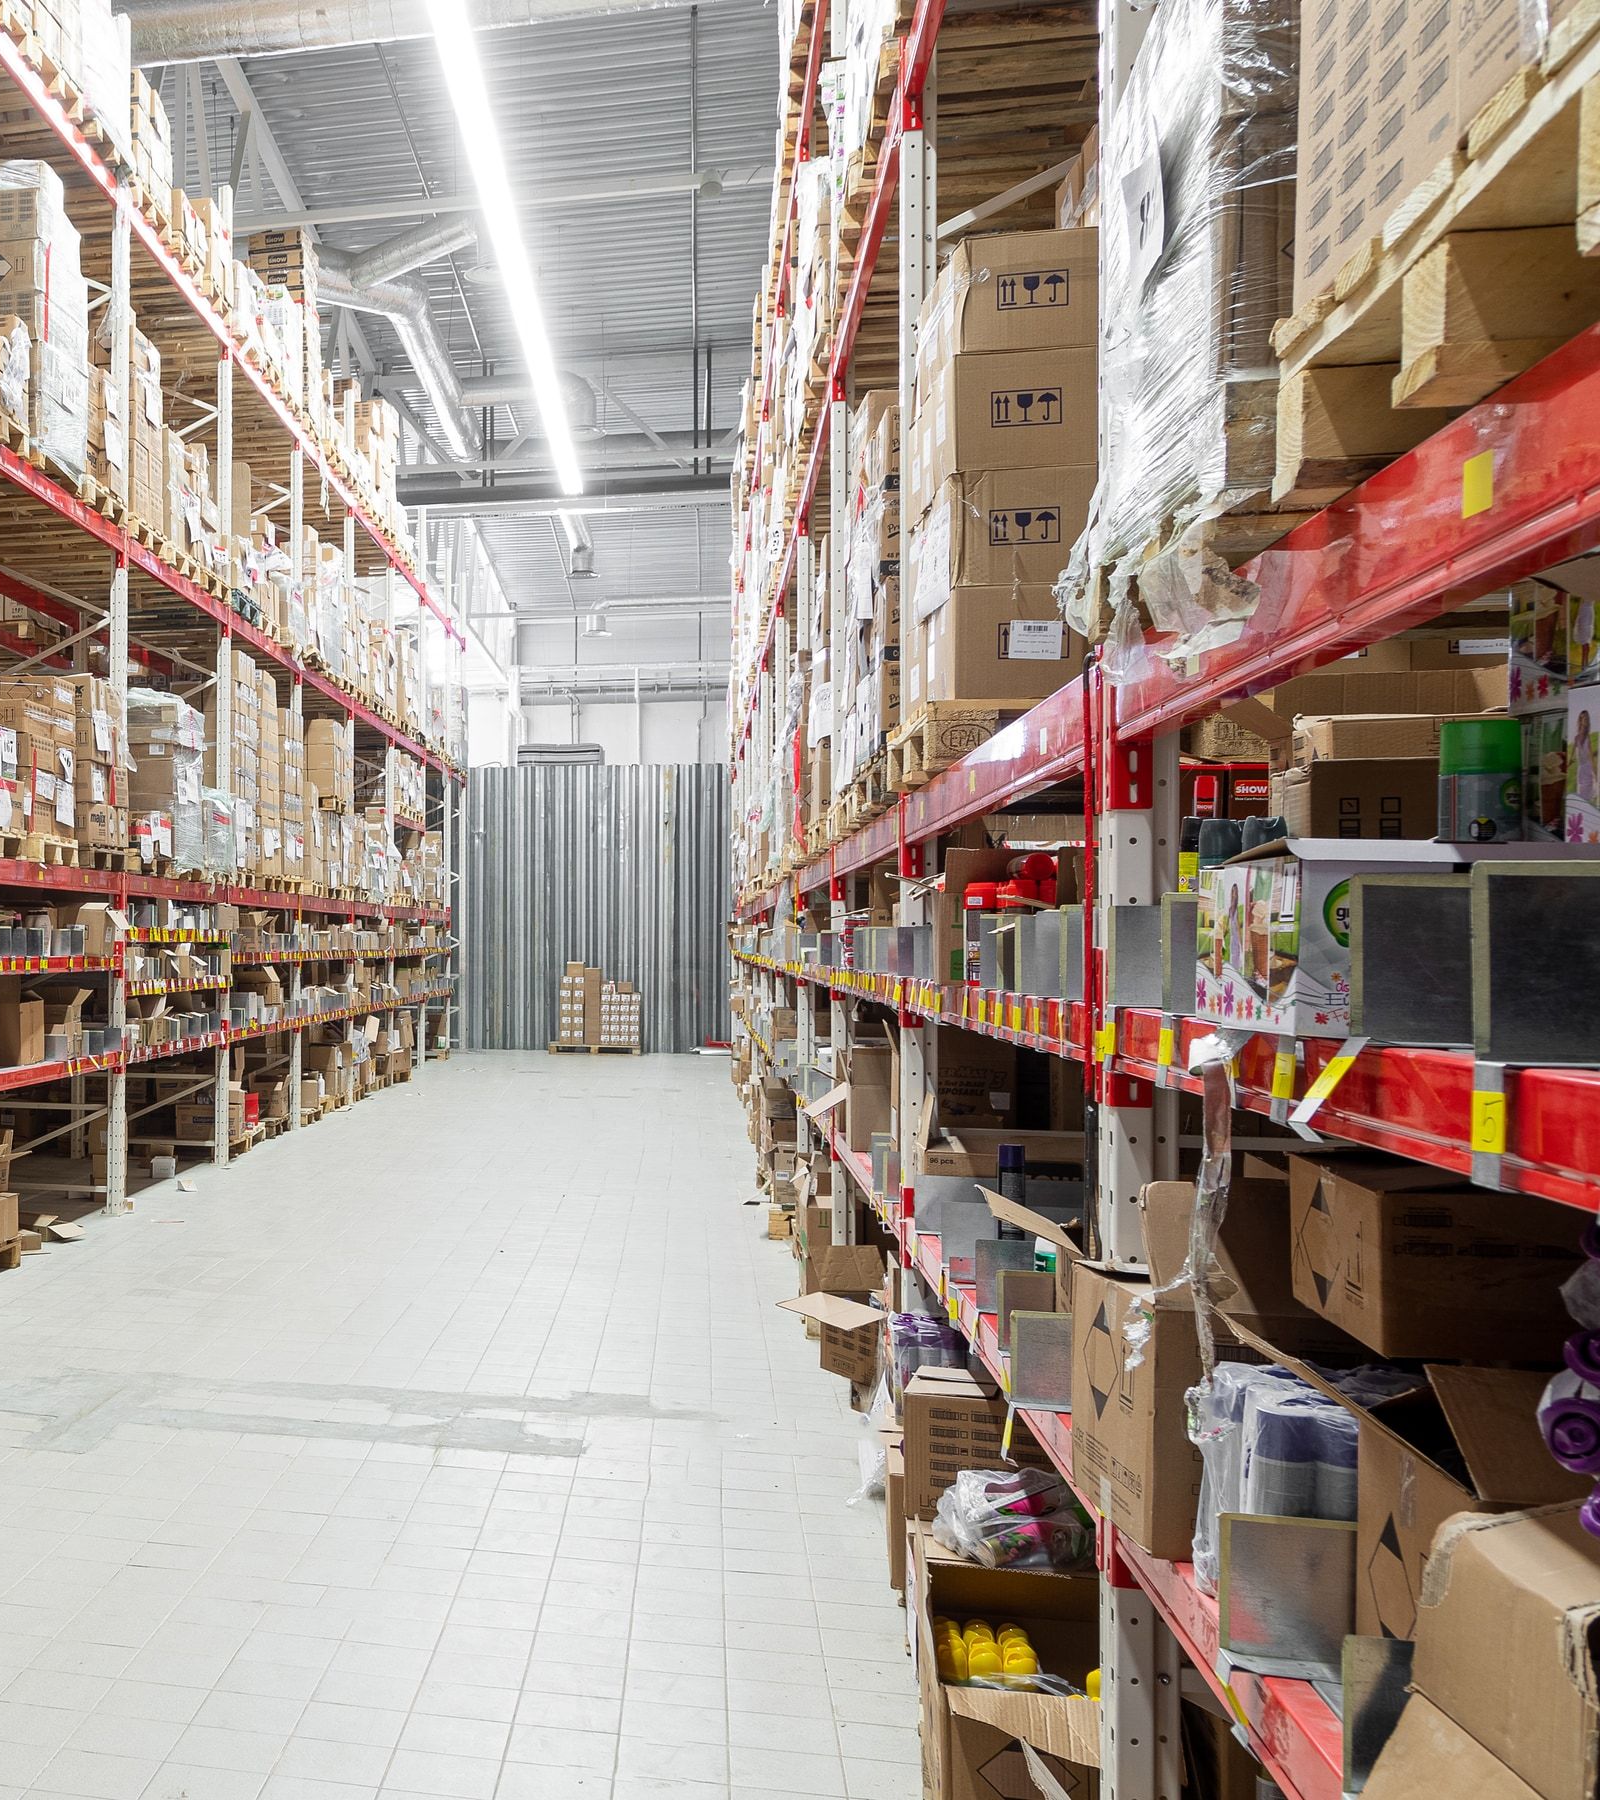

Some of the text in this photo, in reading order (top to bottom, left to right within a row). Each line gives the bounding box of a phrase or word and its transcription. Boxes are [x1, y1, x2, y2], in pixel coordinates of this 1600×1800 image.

[949, 724, 982, 746] EPAL
[1235, 784, 1268, 794] SHOW
[90, 812, 106, 825] majix
[929, 1157, 956, 1167] 96 pcs.
